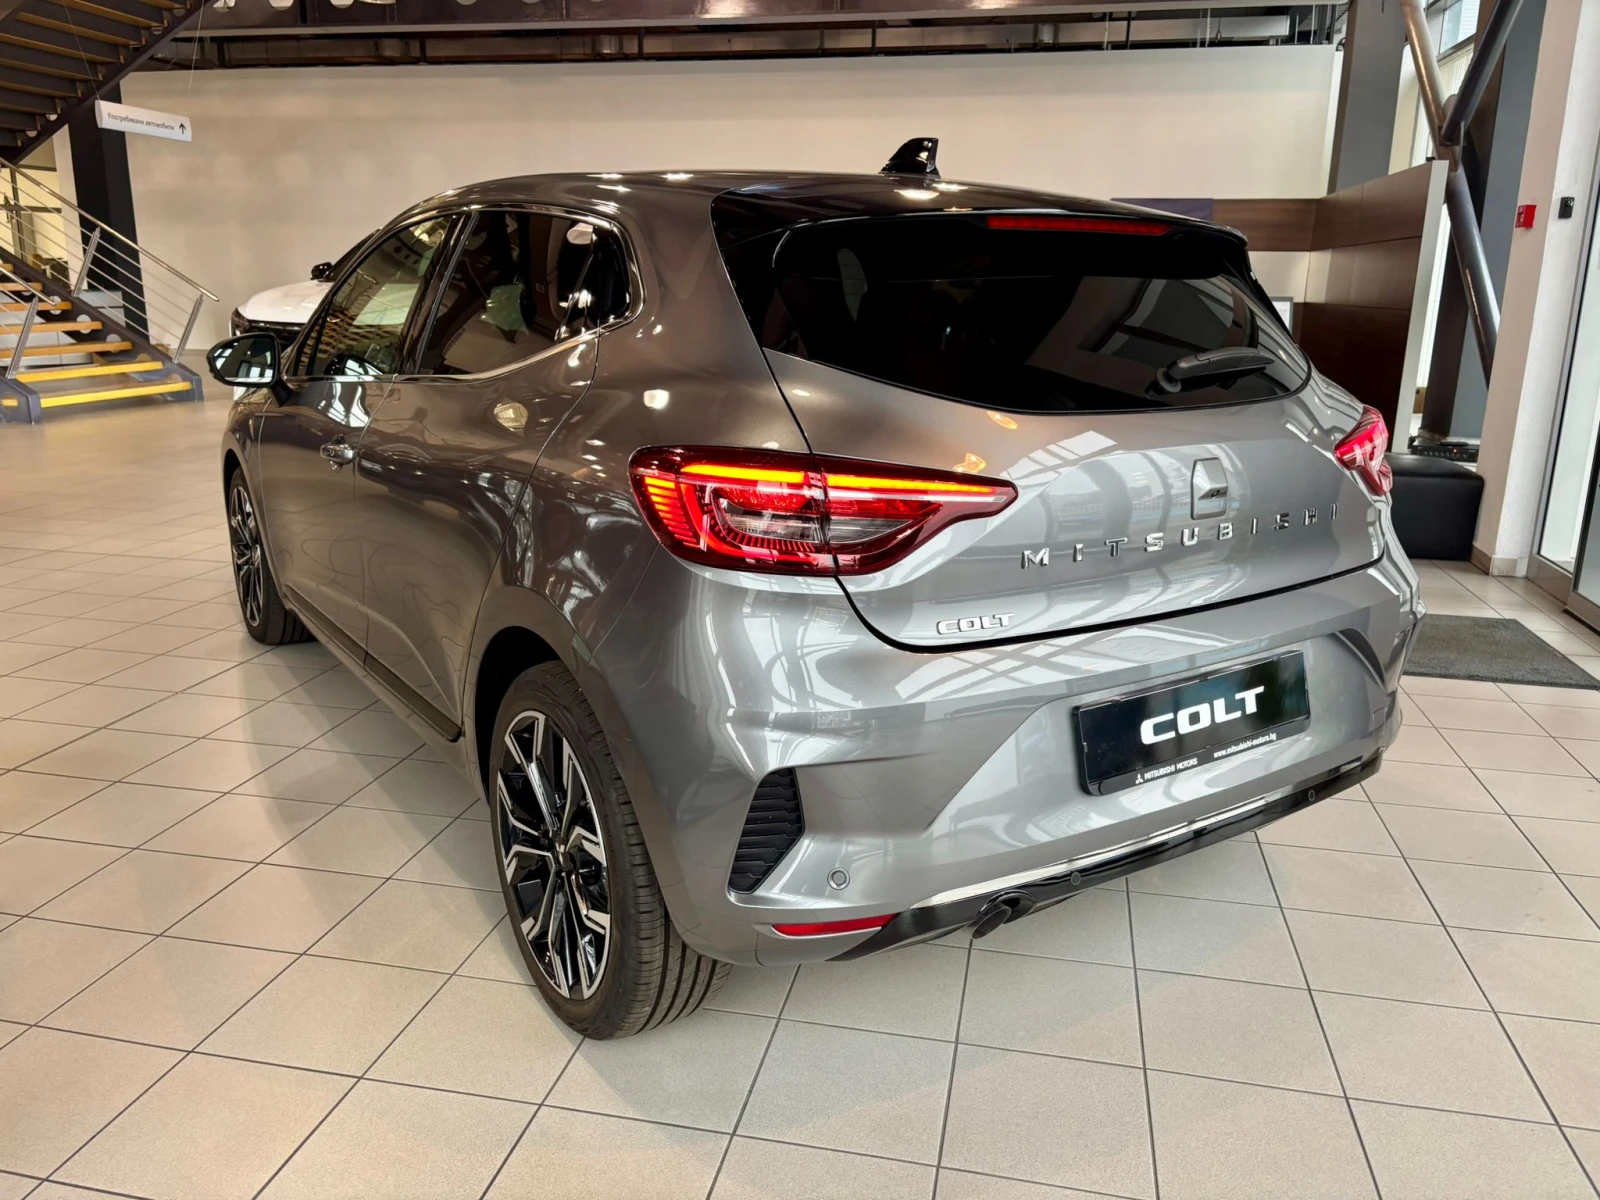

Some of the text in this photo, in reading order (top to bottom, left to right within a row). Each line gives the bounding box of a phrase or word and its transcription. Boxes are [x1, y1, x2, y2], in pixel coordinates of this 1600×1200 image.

[145, 120, 175, 131] автомобили
[1021, 503, 1338, 569] MITSUBISHI
[936, 612, 1015, 635] COLT
[1140, 685, 1265, 745] COLT
[1213, 732, 1277, 759] www.mitsubishi-motors.bg
[1144, 757, 1198, 780] MITSUBISHI MOTORS
